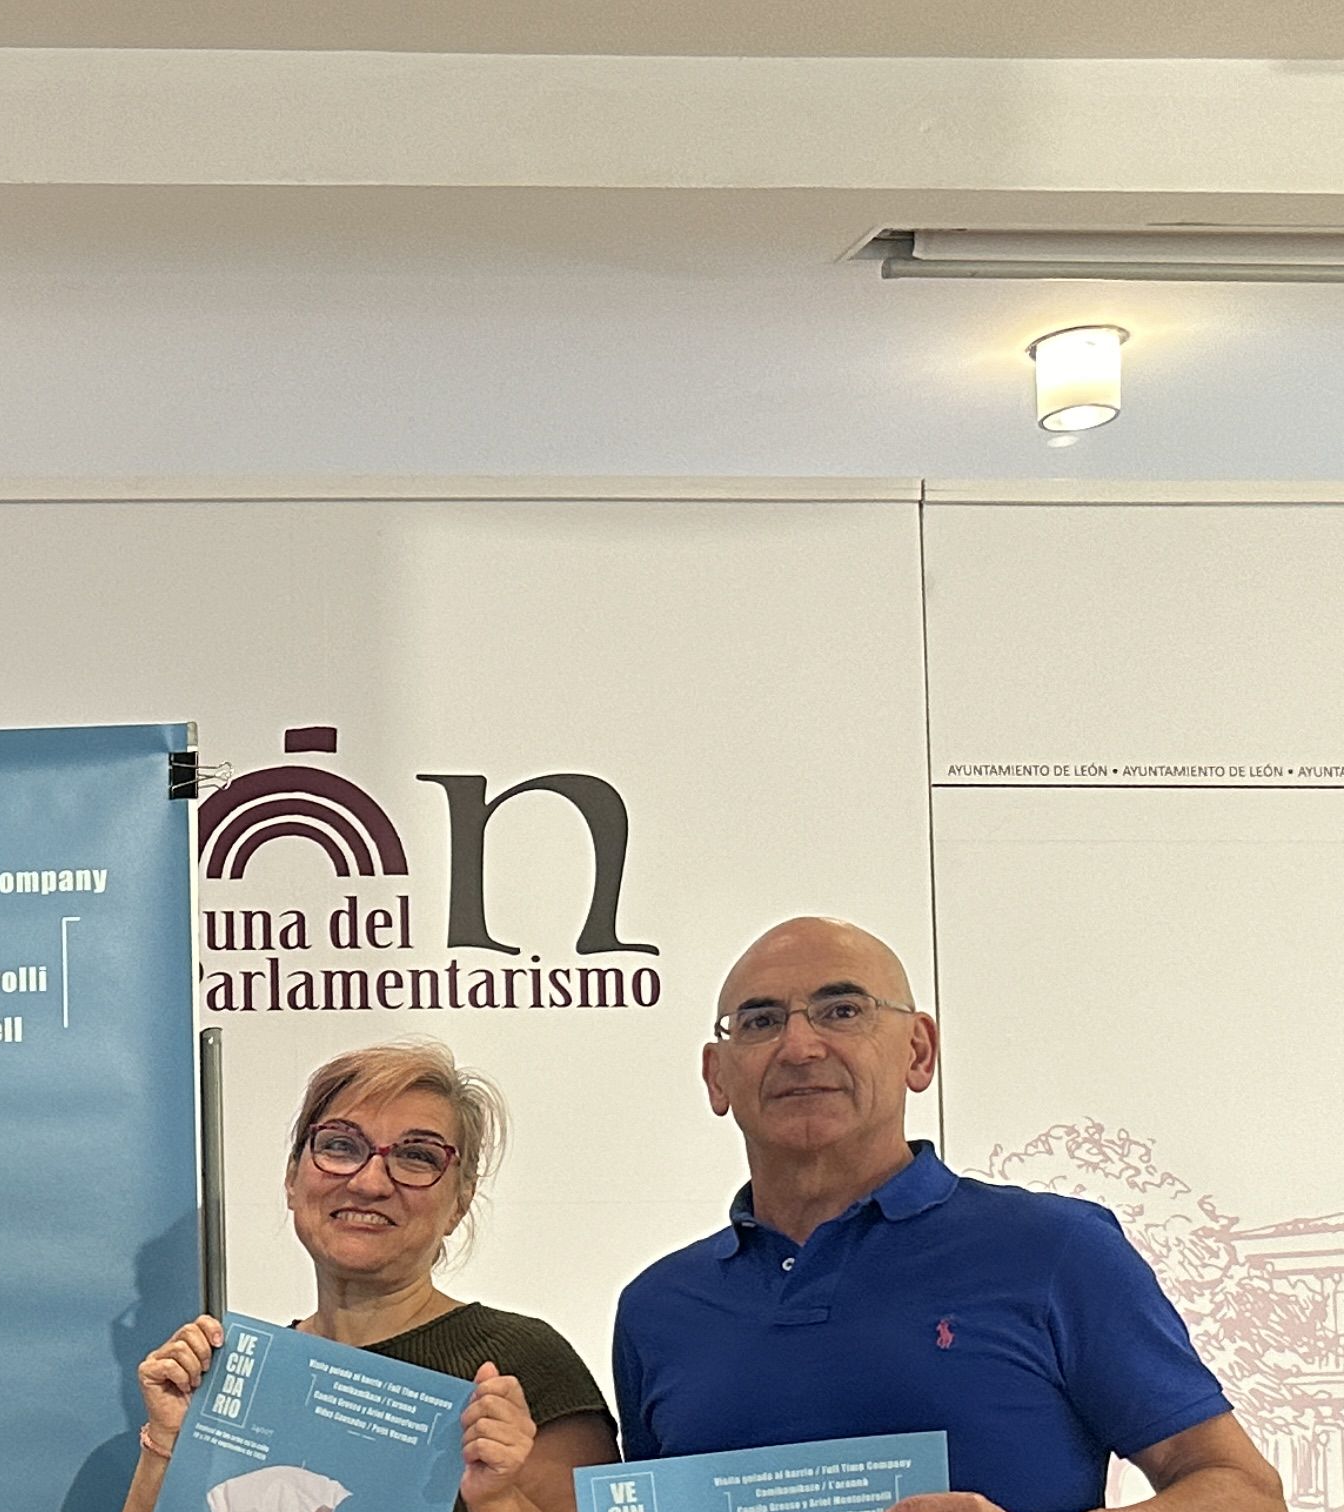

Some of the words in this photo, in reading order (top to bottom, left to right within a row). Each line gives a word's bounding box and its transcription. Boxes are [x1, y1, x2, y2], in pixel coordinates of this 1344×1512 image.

[947, 764, 1050, 778] AYUNTAMIENTO
[1053, 765, 1070, 778] DE
[1074, 762, 1108, 778] LEÓN
[1122, 765, 1226, 779] AYUNTAMIENTO
[1229, 765, 1246, 779] DE
[1249, 762, 1284, 779] LEÓN
[202, 909, 313, 951] una
[329, 895, 414, 950] del
[199, 957, 662, 1012] arlamentarismo
[237, 1332, 258, 1356] VE
[226, 1352, 255, 1378] CIN
[222, 1373, 245, 1398] DA
[212, 1393, 242, 1420] RIO
[610, 1481, 638, 1504] VE
